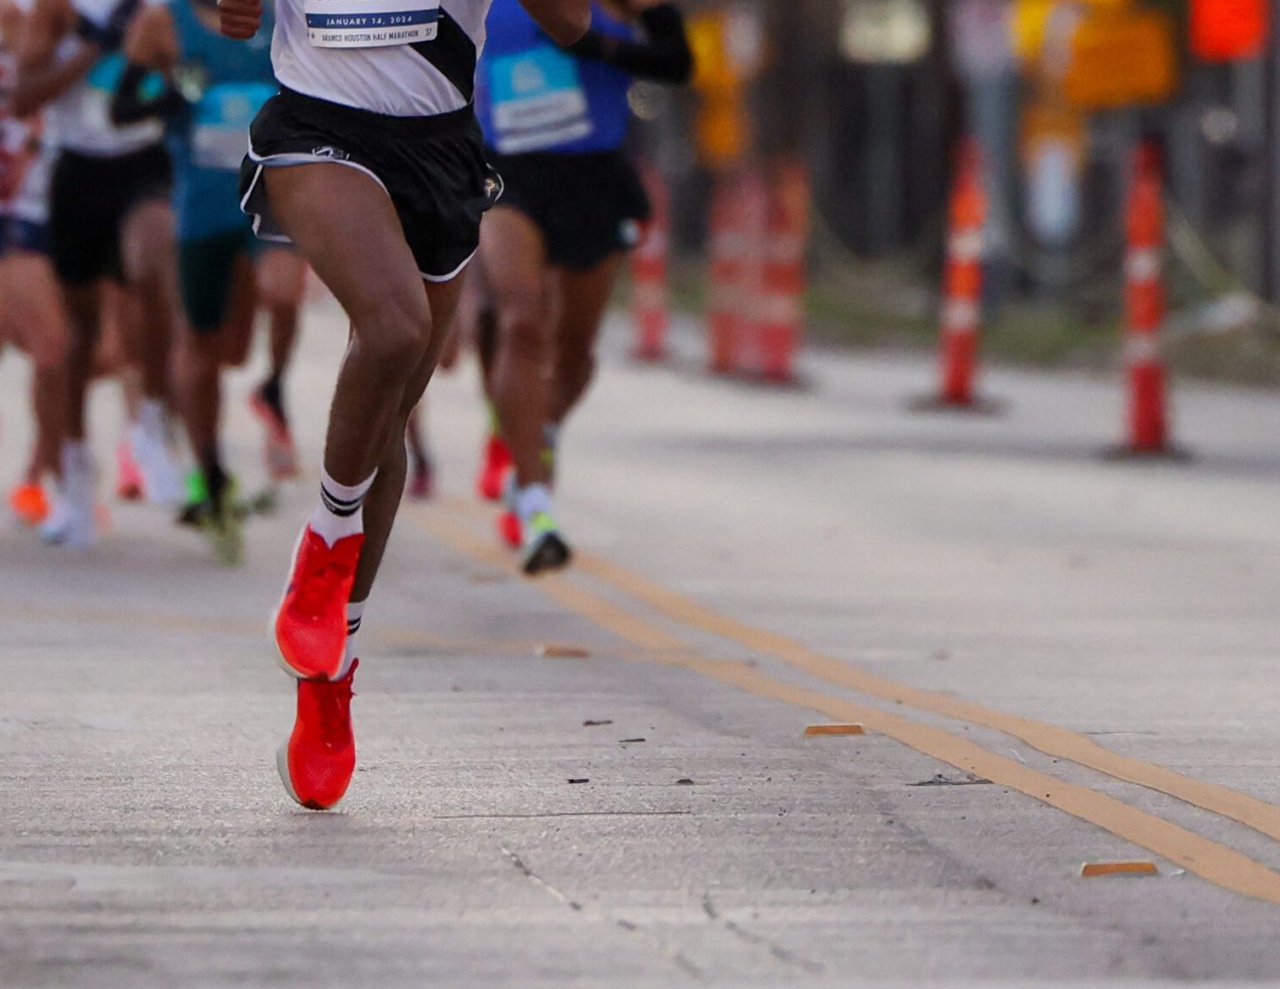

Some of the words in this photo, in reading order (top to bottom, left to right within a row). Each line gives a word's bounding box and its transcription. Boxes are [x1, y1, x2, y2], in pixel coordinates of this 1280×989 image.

[326, 17, 367, 26] JANUARY
[372, 17, 385, 25] 14,
[390, 16, 412, 24] 2024
[344, 33, 371, 42] HOUSTON
[372, 32, 386, 41] HALF
